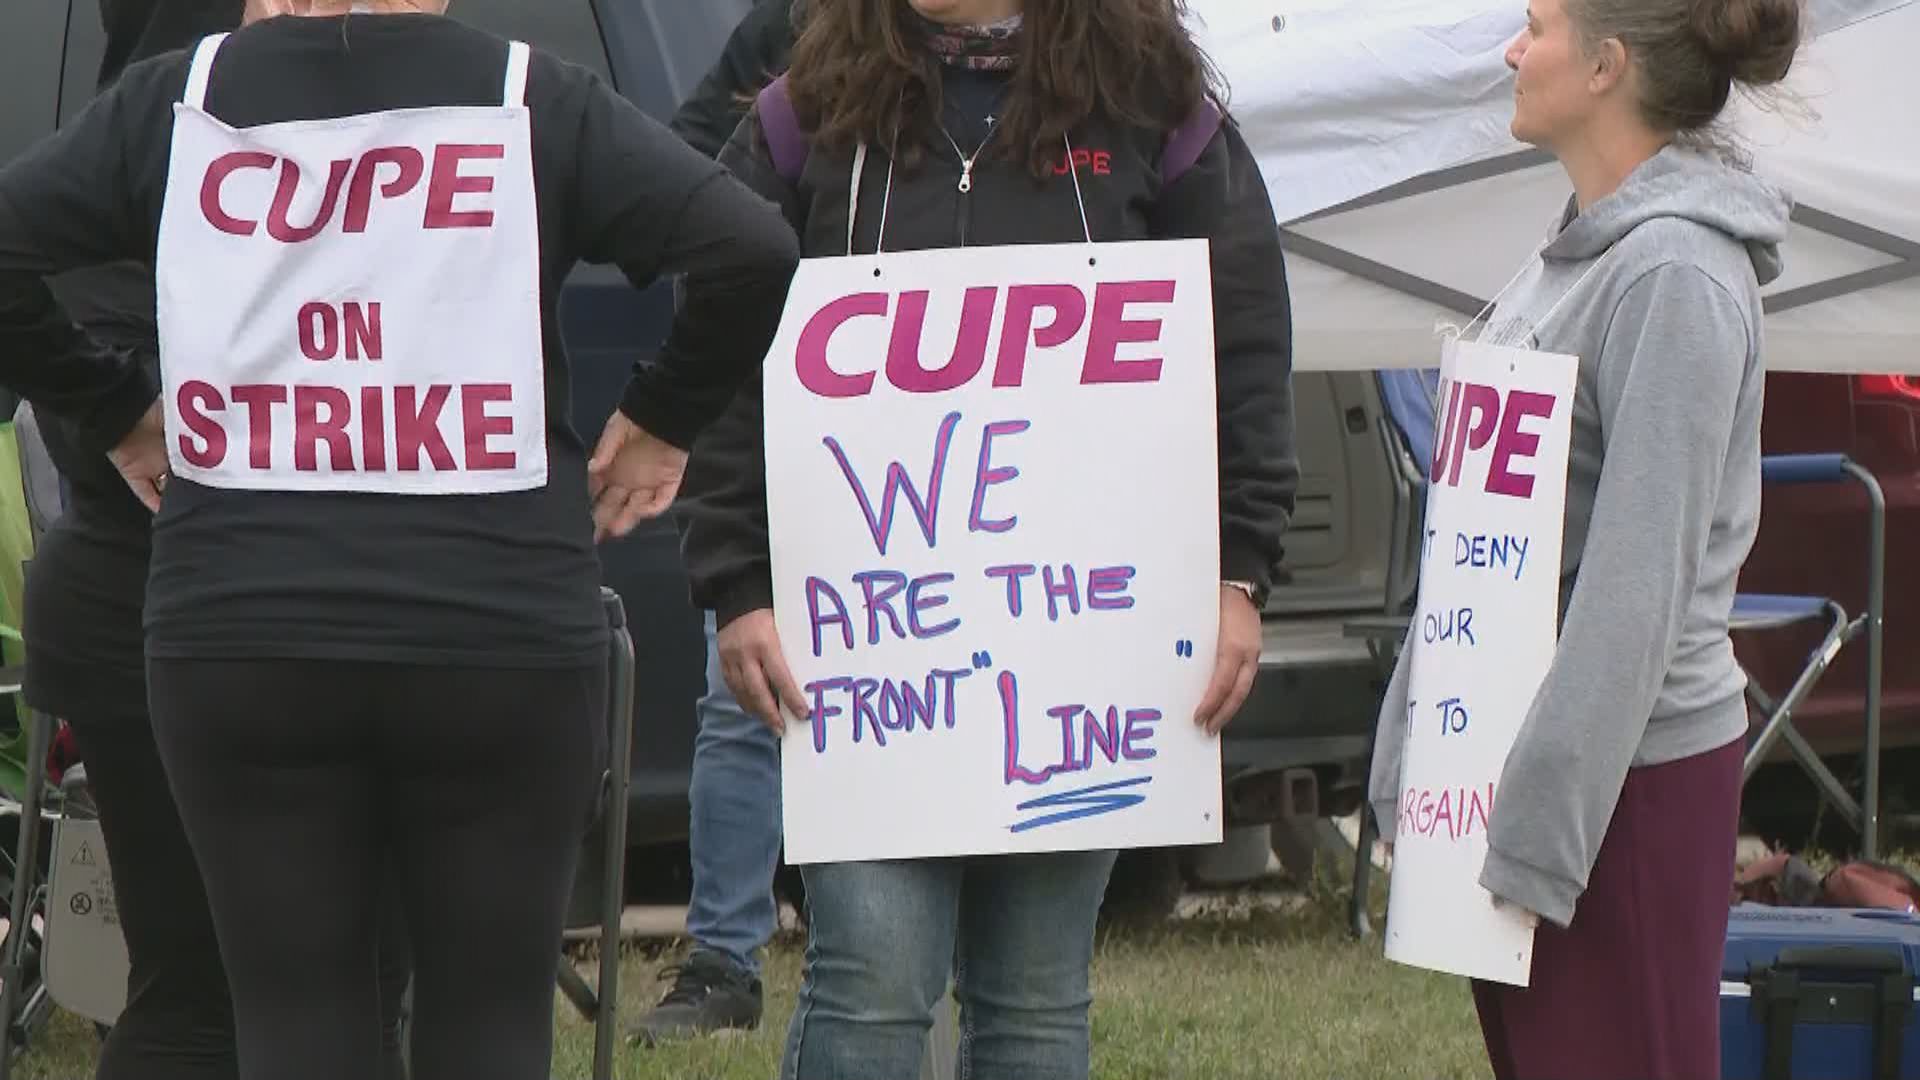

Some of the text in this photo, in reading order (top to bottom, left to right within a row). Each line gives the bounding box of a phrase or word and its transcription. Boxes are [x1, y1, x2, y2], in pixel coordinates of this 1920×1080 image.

[200, 144, 504, 243] CUPE
[1053, 148, 1111, 175] UPE
[298, 302, 382, 360] ON
[795, 279, 1176, 398] CUPE
[177, 380, 516, 471] STRIKE
[1430, 377, 1556, 498] UPE
[824, 411, 1032, 556] WE
[1455, 532, 1528, 580] DENY
[807, 564, 1137, 656] ARE THE
[1424, 608, 1475, 645] OUR
[805, 667, 973, 753] FRONT
[1436, 698, 1468, 735] TO
